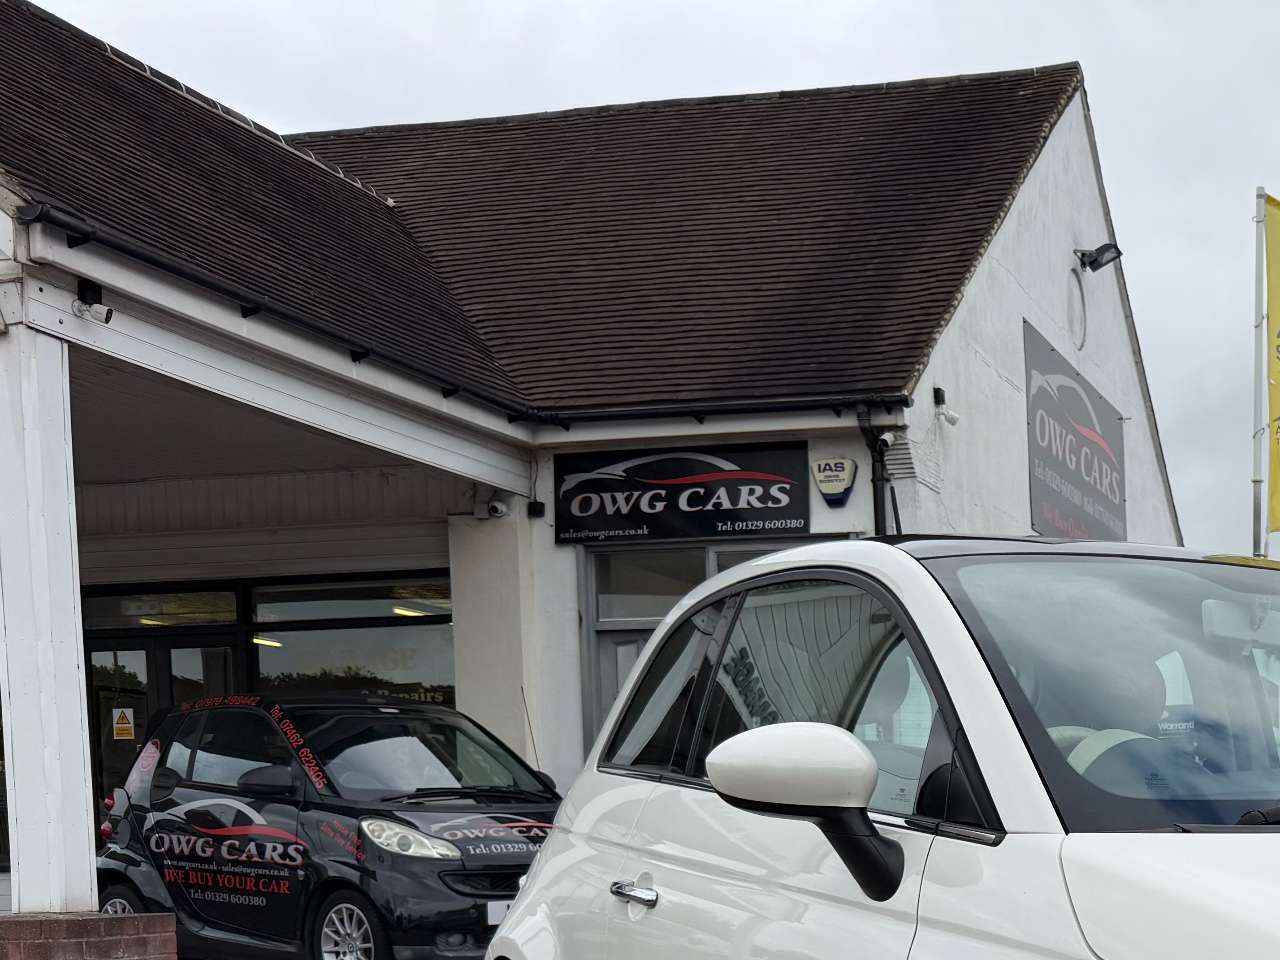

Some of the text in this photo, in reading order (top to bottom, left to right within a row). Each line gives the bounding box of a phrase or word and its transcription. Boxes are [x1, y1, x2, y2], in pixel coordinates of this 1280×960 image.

[1034, 408, 1120, 505] OWG CARS
[817, 461, 846, 473] IAS
[569, 483, 792, 517] OWG CARS
[717, 519, 805, 531] Tel: 01329 600380
[270, 704, 282, 721] Tel:
[442, 827, 507, 840] OWG
[149, 832, 214, 858] OWG
[220, 839, 305, 866] CARS
[466, 843, 490, 855] Tel:
[491, 842, 527, 854] 01329
[164, 868, 290, 895] WE BUY YOUR CAR
[190, 888, 267, 907] Tel: 01329 600380
